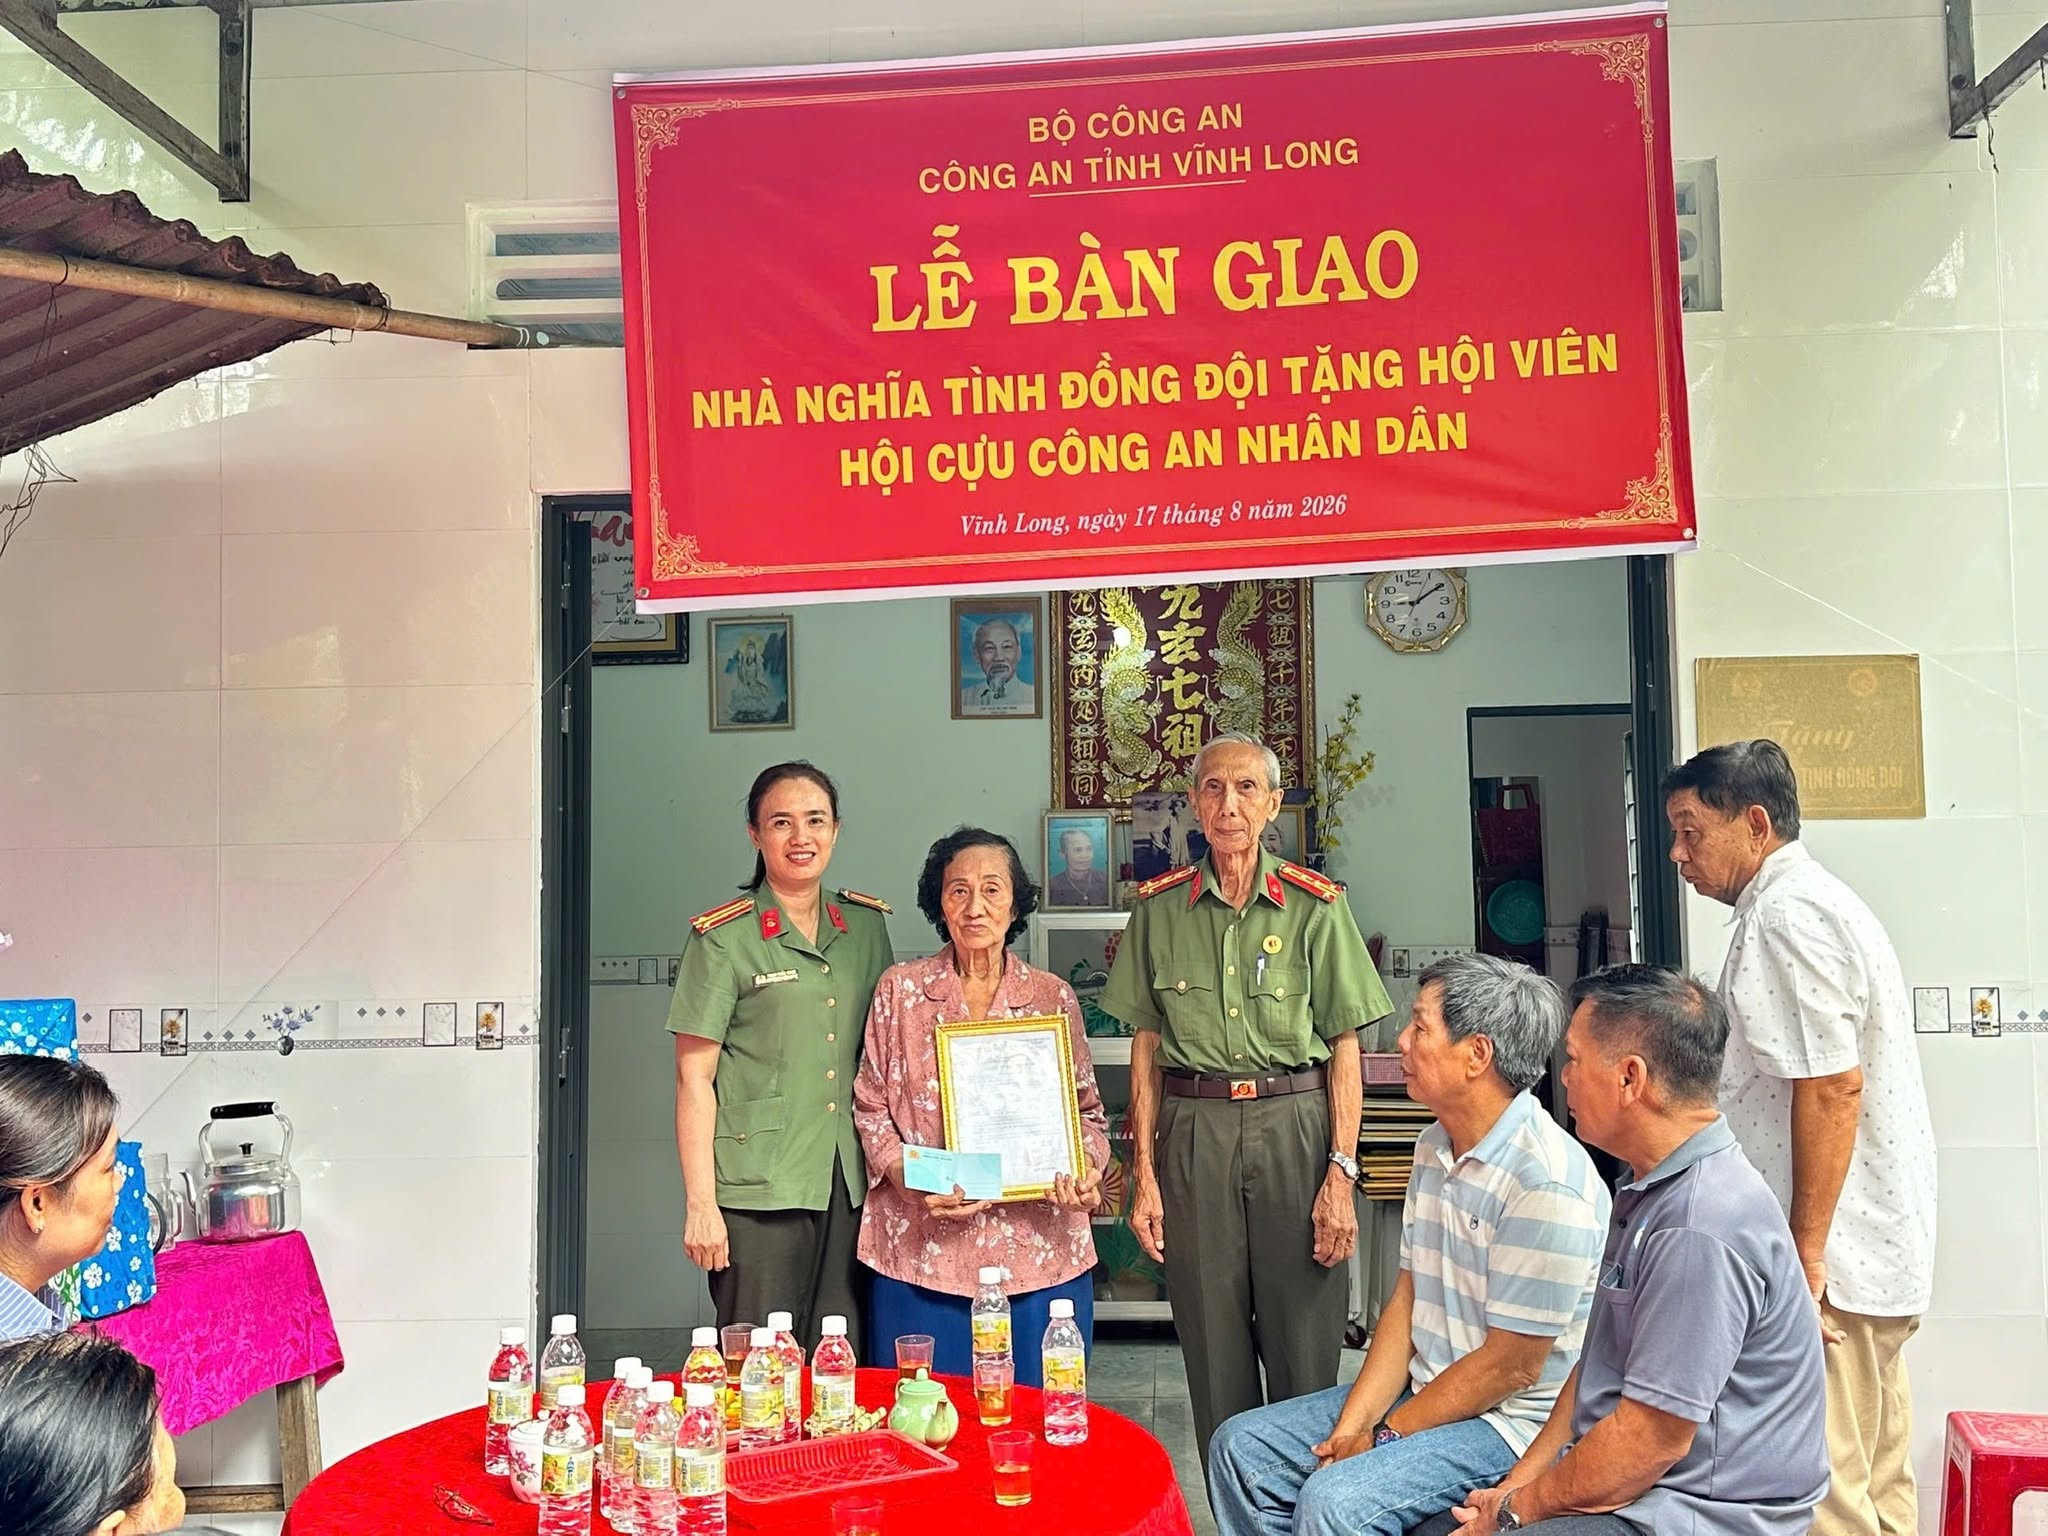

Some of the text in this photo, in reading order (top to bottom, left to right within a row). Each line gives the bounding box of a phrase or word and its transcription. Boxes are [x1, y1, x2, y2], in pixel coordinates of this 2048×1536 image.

[1028, 102, 1243, 147] BỘ CÔNG AN
[918, 137, 1359, 194] CÔNG AN TỈNH VĨNH LONG
[869, 224, 1419, 333] LỄ BÀN GIAO
[692, 326, 1618, 429] NHÀ NGHĨA TÌNH ĐỒNG ĐỘI TẶNG HỘI VIÊN
[840, 405, 1468, 497] HỘI CỰU CÔNG AN NHÂN DÂN
[960, 493, 1348, 537] Vĩnh Long, ngày 17 tháng 8 năm 2026
[1394, 574, 1404, 583] 11
[1384, 586, 1397, 595] 10
[1380, 600, 1391, 609] 9
[1439, 596, 1450, 605] 3
[1386, 614, 1396, 623] 8
[1436, 611, 1446, 620] 4
[1397, 624, 1406, 633] 7
[1427, 622, 1437, 632] 5
[1412, 628, 1422, 637] 6
